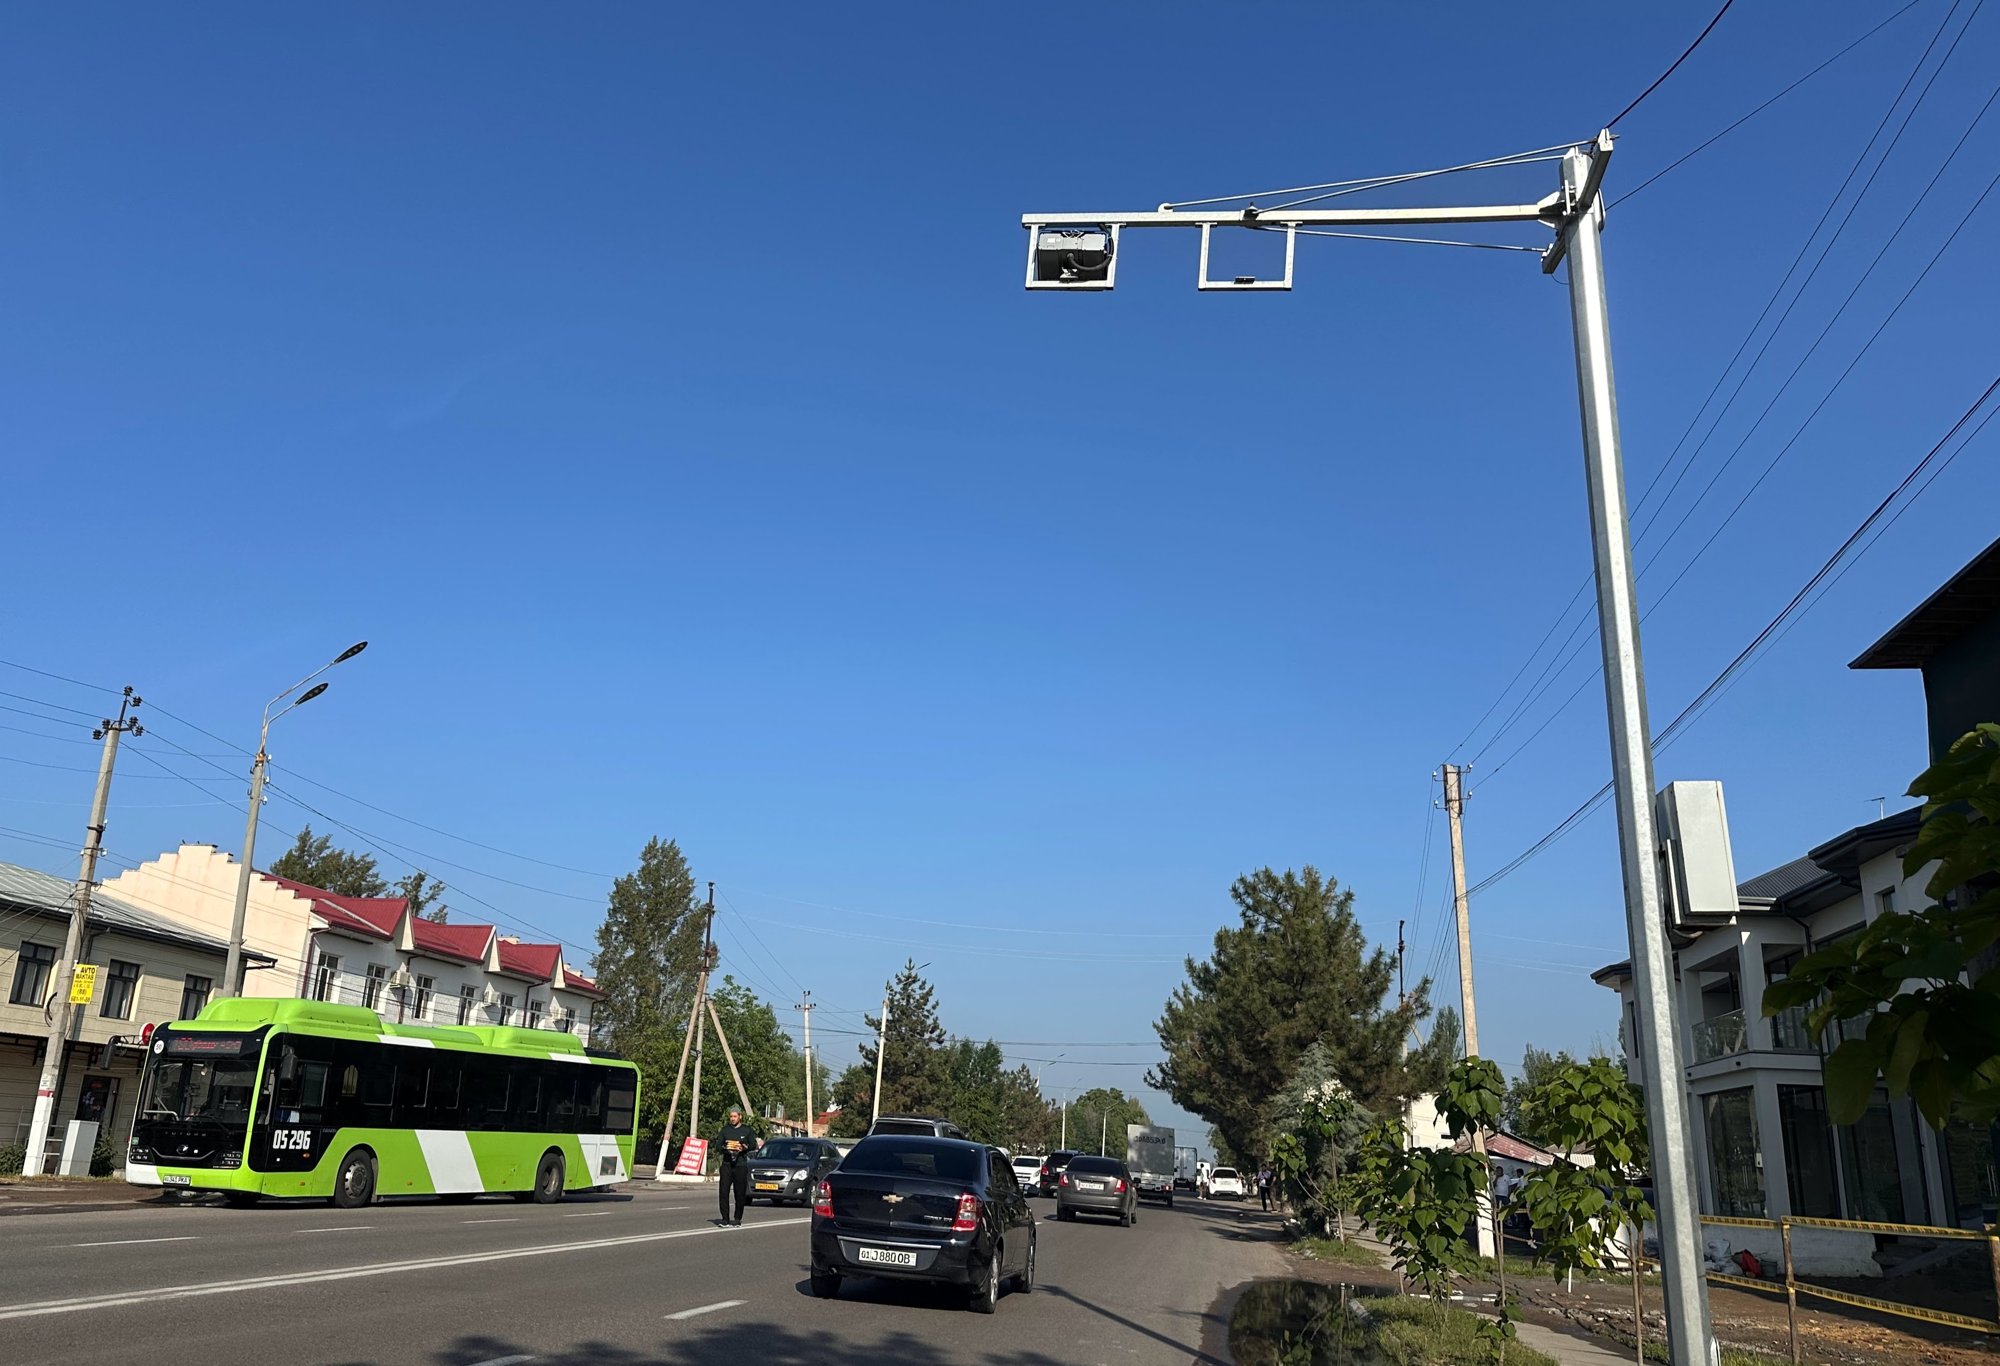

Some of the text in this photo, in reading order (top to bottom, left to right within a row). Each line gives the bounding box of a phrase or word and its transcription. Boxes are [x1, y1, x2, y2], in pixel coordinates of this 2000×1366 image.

[273, 1130, 311, 1150] 05 296
[861, 1250, 870, 1259] 01
